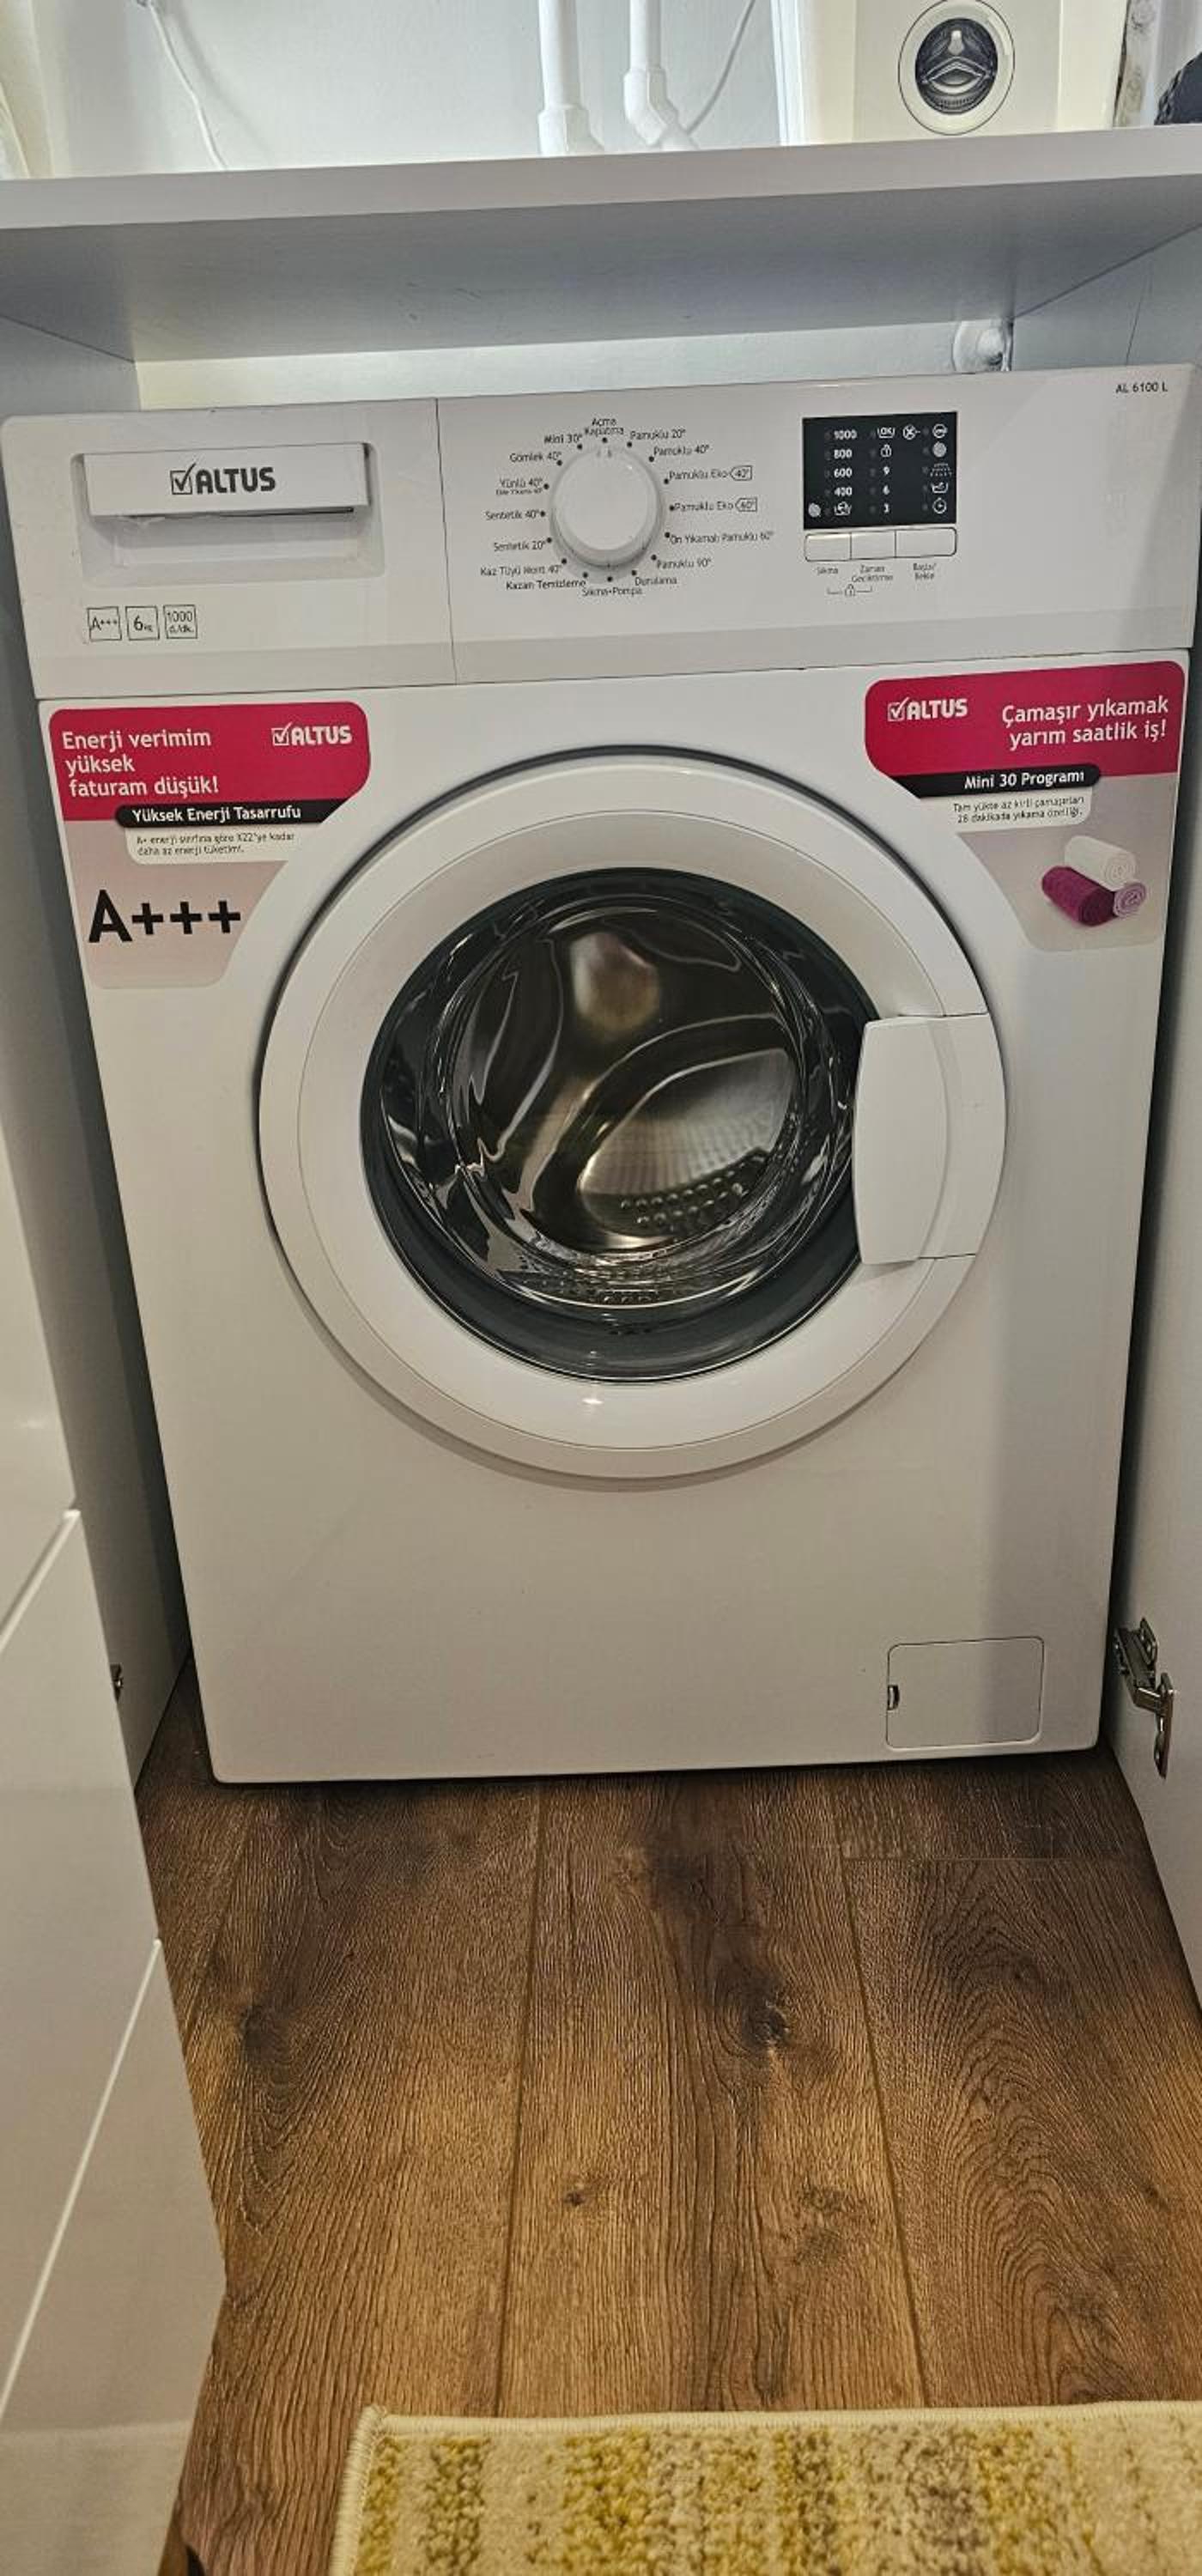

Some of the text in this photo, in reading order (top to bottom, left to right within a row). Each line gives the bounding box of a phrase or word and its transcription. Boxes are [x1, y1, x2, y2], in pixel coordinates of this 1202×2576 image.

[1116, 382, 1169, 393] AL 6100 L
[630, 430, 668, 440] Pamuklu
[834, 429, 857, 440] 1000
[653, 447, 690, 456] Pamuklu
[834, 449, 852, 459] 800
[669, 470, 707, 480] Pamuklu
[834, 467, 852, 477] 600
[883, 466, 889, 475] 9
[196, 467, 276, 495] ALTUS
[834, 486, 852, 496] 400
[674, 501, 713, 511] Pamuklu
[657, 559, 694, 569] Pamuklu
[506, 580, 534, 591] Kazan
[908, 698, 968, 720] ALTUS
[1002, 696, 1169, 727] Çamaşır yıkamak
[62, 728, 212, 752] Enerji verimim
[292, 726, 353, 745] ALTUS
[1010, 720, 1167, 751] yarım saatlik iş!
[65, 754, 135, 776] yüksek
[964, 770, 1084, 789] Mini 30 Programı
[69, 775, 219, 798] faturam düşük!
[131, 805, 301, 823] Yüksek Enerji Tasarrufu
[88, 890, 241, 943] A+++
